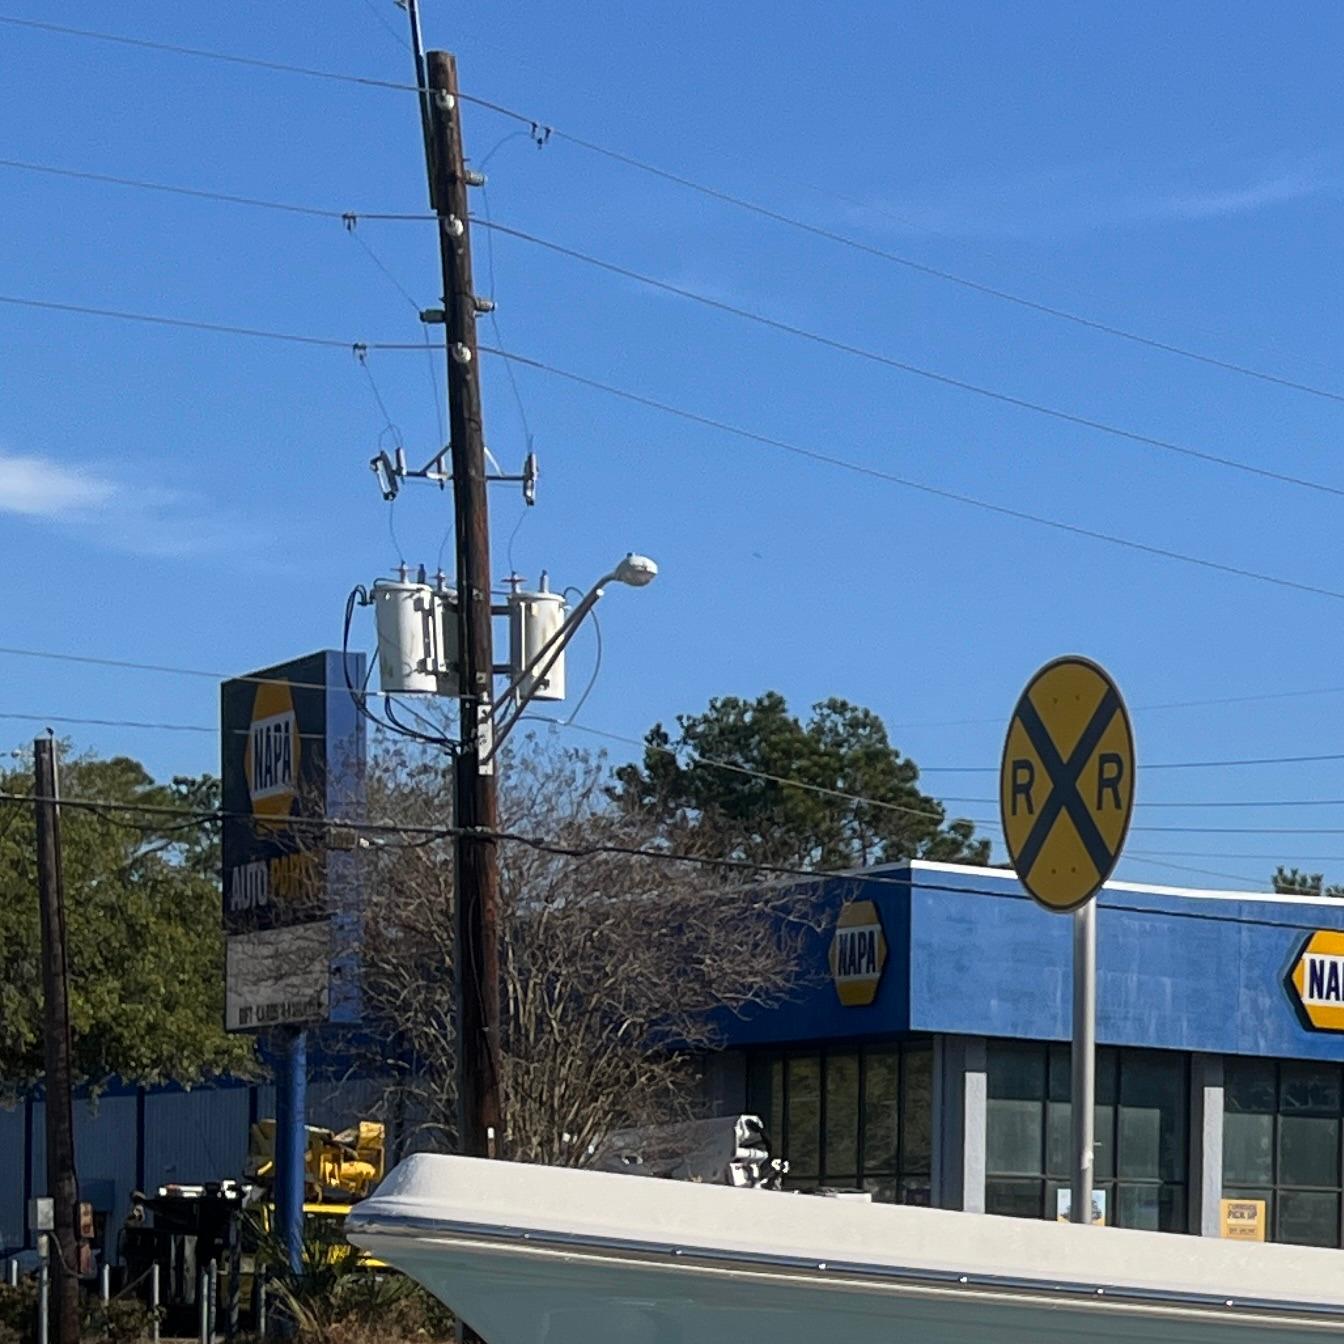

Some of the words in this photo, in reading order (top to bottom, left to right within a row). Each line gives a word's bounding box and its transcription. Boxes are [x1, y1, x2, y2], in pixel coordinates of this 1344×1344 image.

[254, 720, 292, 792] NAPA
[1011, 759, 1035, 816] R
[1096, 752, 1124, 811] R
[231, 860, 268, 912] AUTO
[269, 847, 323, 900] PAR
[838, 929, 877, 977] NAPA
